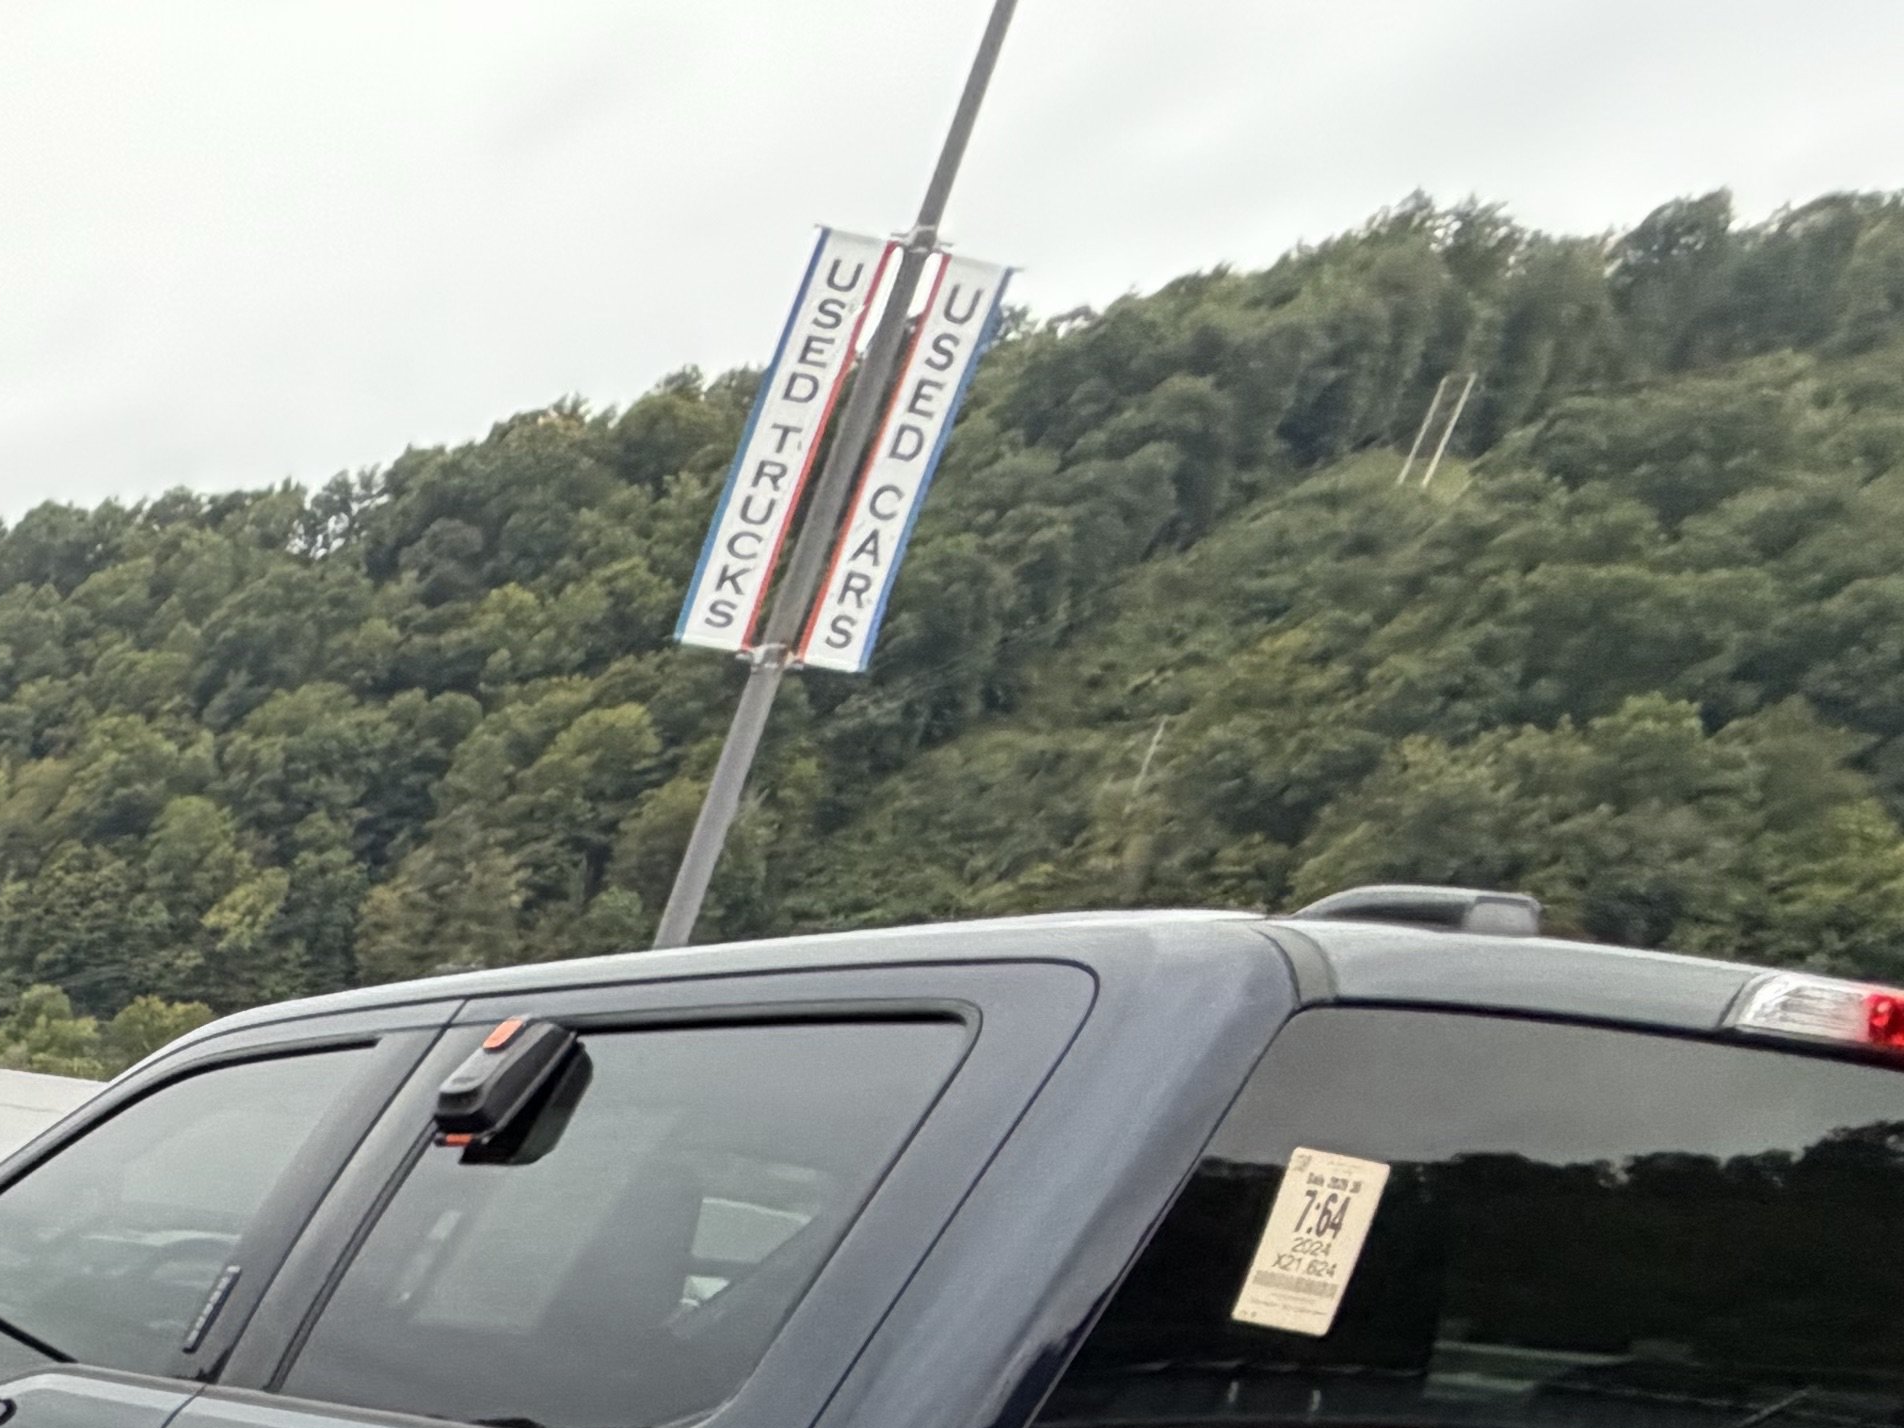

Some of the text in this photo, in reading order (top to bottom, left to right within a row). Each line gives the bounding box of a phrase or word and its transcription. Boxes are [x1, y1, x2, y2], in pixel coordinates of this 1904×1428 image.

[704, 258, 864, 629] USED TRUCKS
[825, 283, 985, 650] USED CARS
